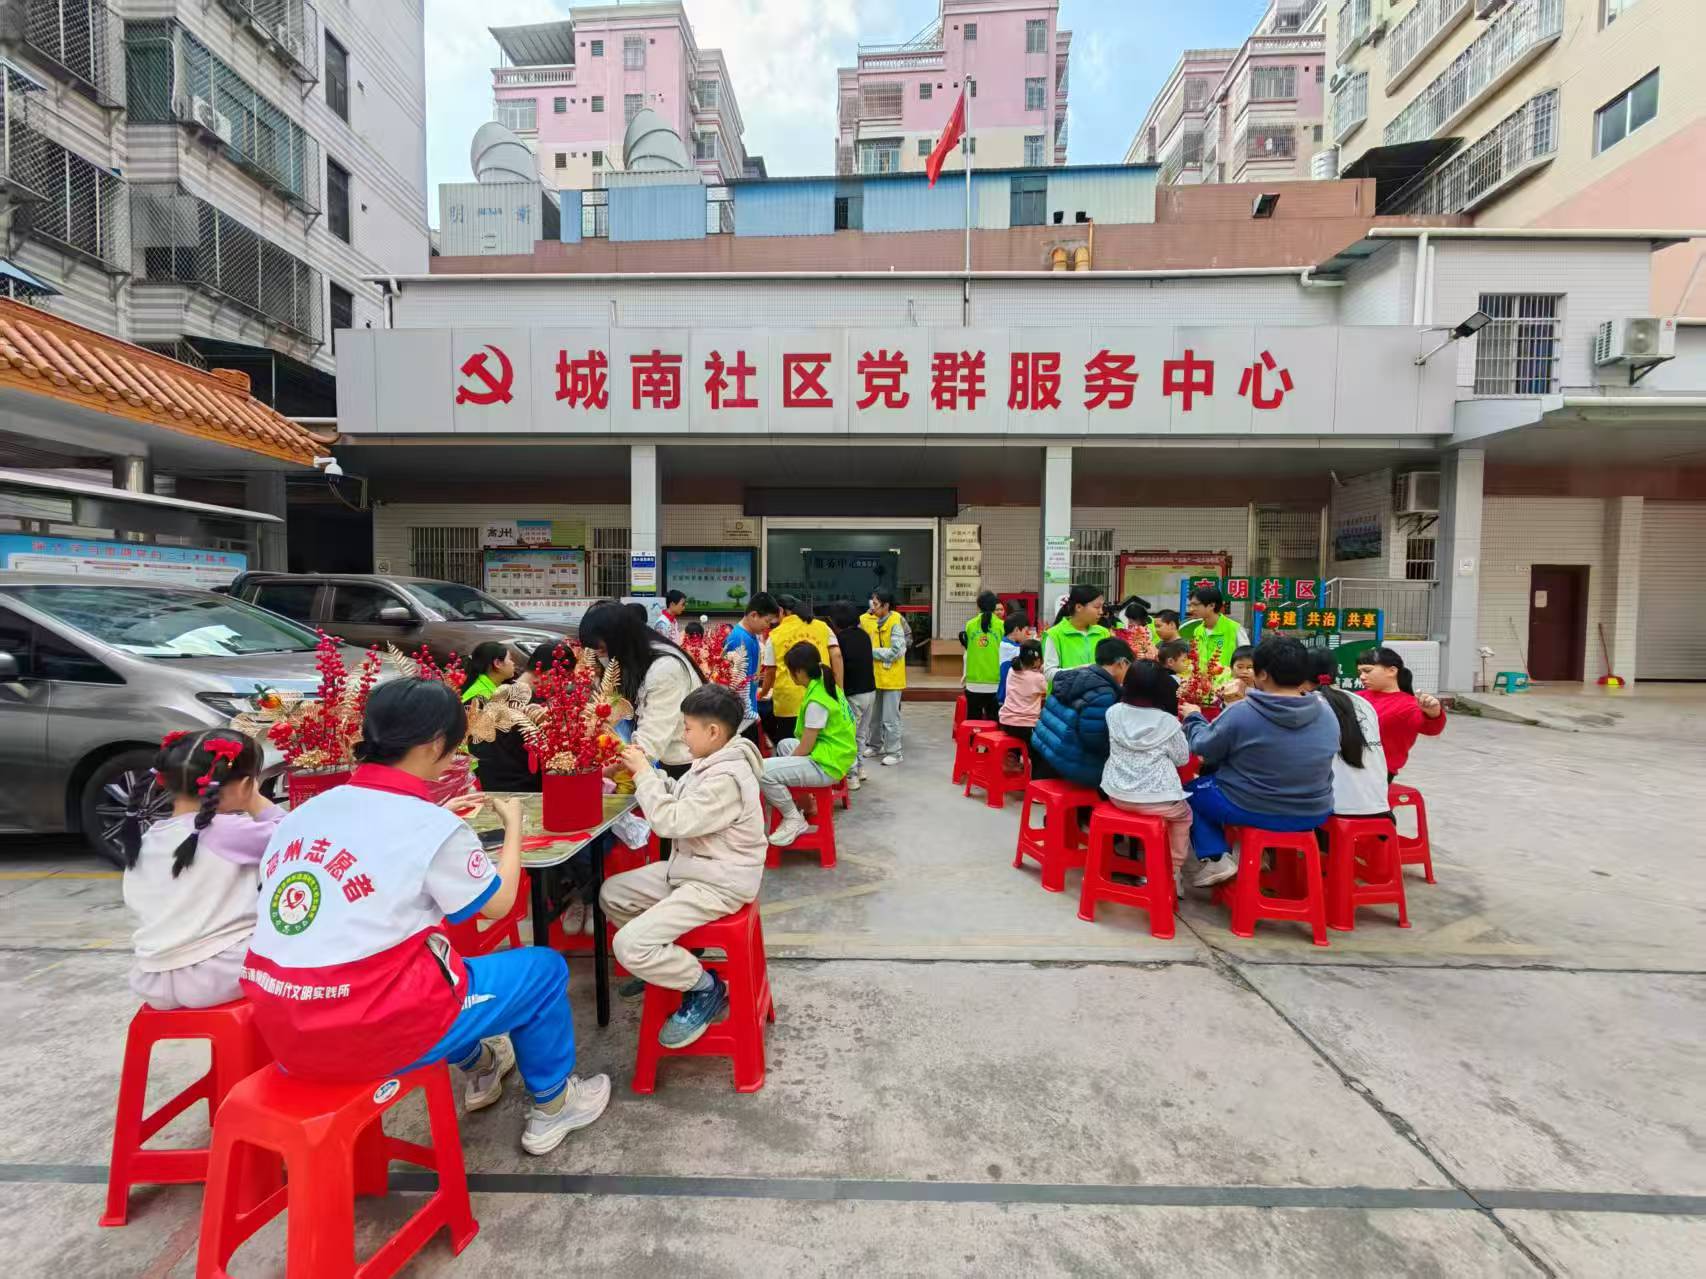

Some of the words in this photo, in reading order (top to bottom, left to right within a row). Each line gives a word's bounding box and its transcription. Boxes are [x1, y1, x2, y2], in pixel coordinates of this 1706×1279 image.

[555, 349, 1293, 412] 城南社区党群服务中心
[1267, 610, 1297, 627] 共建
[1307, 611, 1336, 627] 共治
[1347, 611, 1377, 627] 共享
